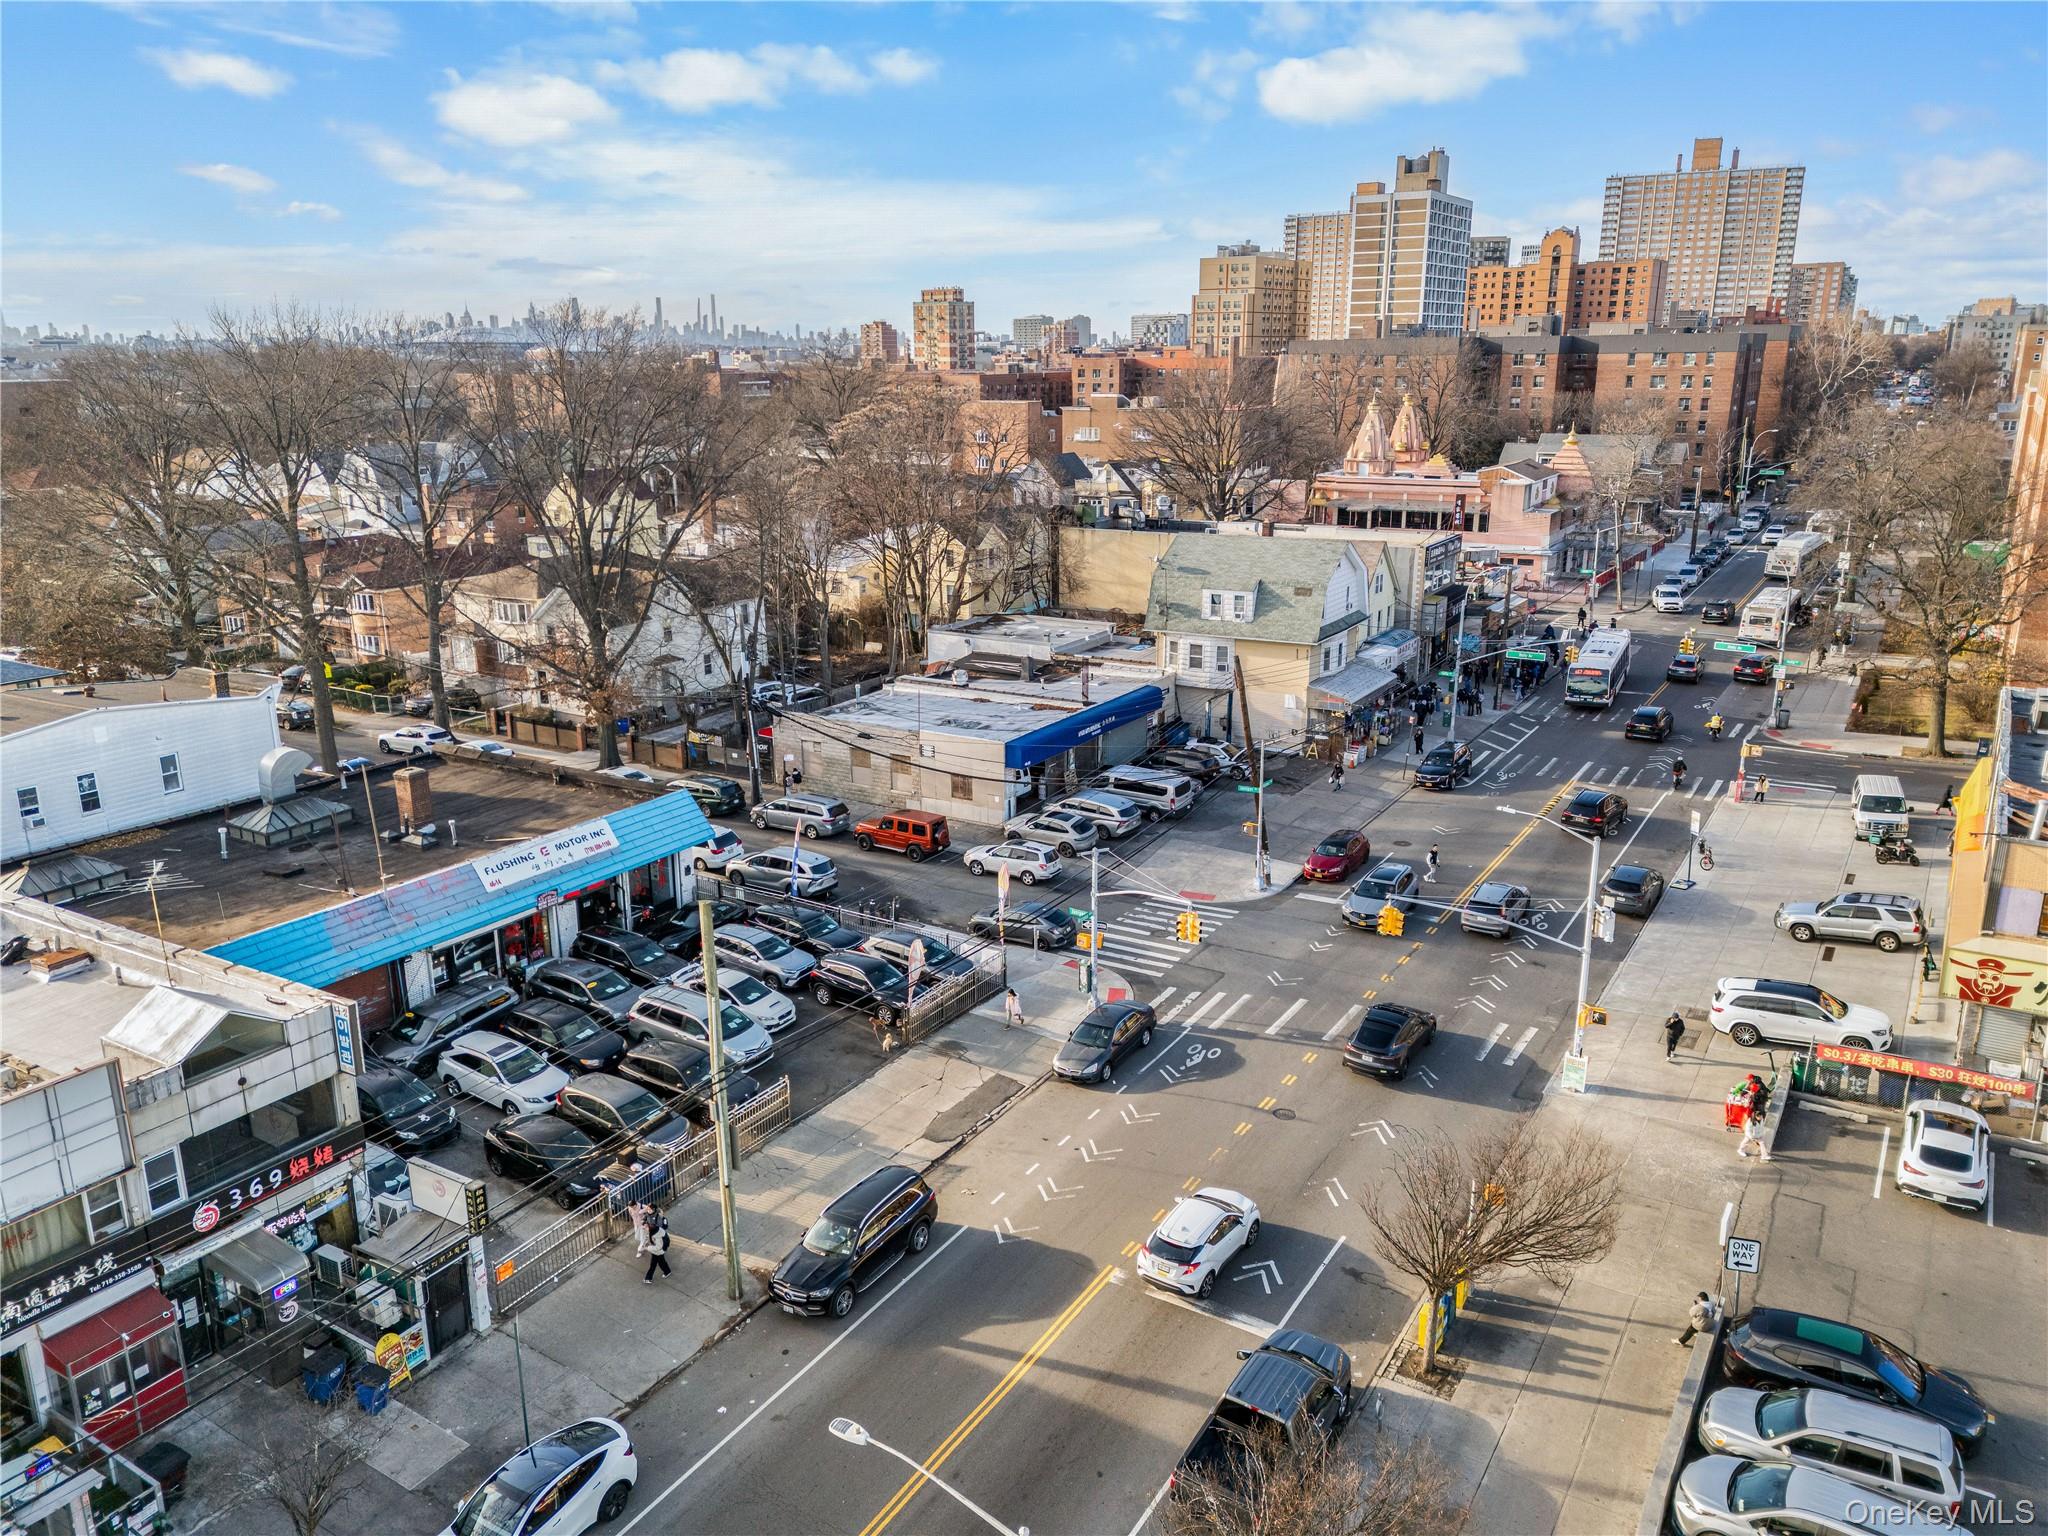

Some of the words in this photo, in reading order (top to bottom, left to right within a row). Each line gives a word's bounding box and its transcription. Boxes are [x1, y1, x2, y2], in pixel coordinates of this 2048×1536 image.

[484, 852, 535, 875] FLUSHING
[555, 833, 588, 851] MOTOR
[589, 828, 606, 840] INC
[1732, 1250, 1755, 1260] WAY
[1733, 1241, 1755, 1252] ONE
[17, 1307, 41, 1324] Noodle
[41, 1298, 62, 1312] House
